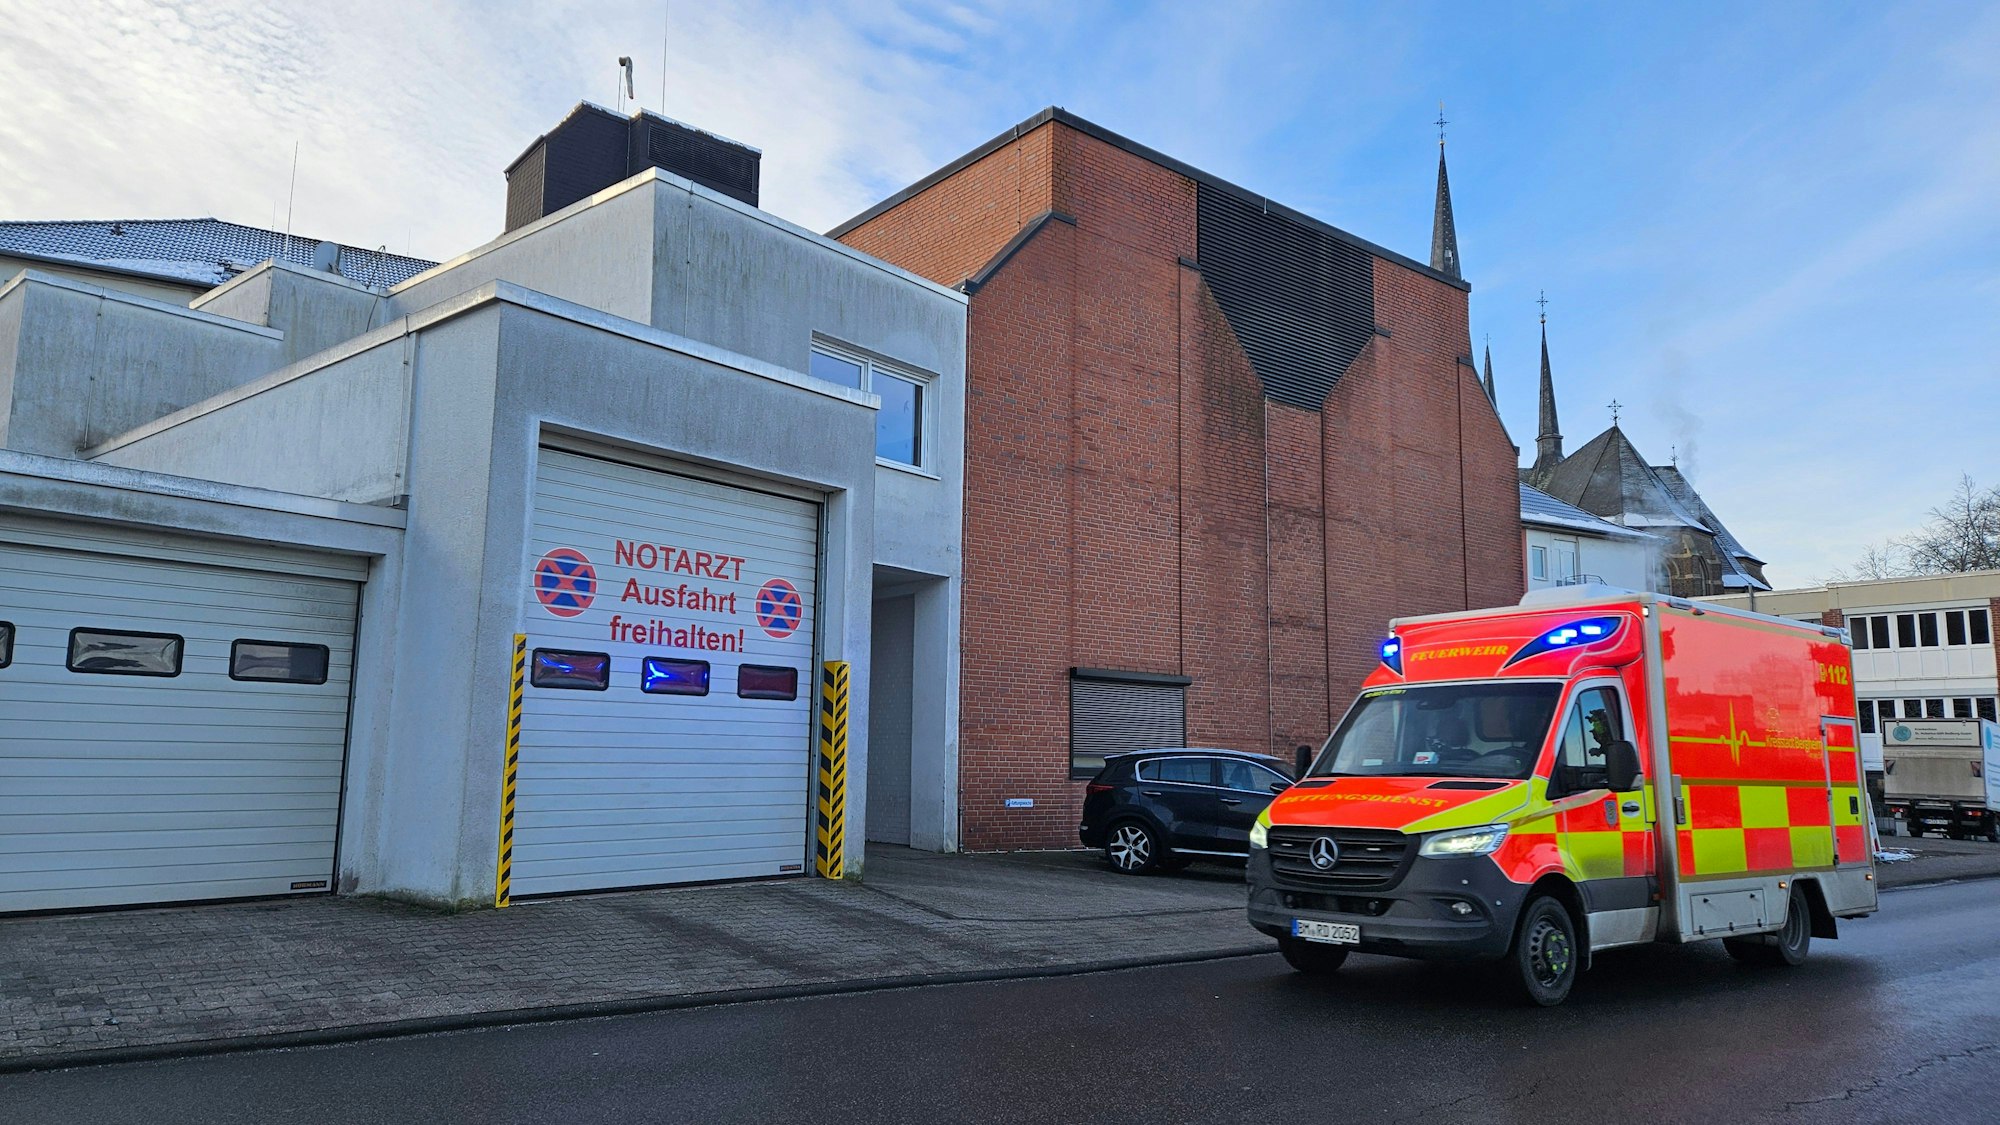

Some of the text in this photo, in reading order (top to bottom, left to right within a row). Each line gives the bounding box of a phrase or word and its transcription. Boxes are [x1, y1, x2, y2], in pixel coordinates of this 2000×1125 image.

[615, 540, 745, 581] NOTARZT
[621, 577, 737, 615] Ausfahrt
[609, 614, 744, 653] freihalten!
[1410, 645, 1509, 662] FEUERWEHR
[1827, 664, 1848, 686] 112
[1279, 793, 1449, 808] RETTUNGSDIENST
[1331, 926, 1358, 941] 2052
